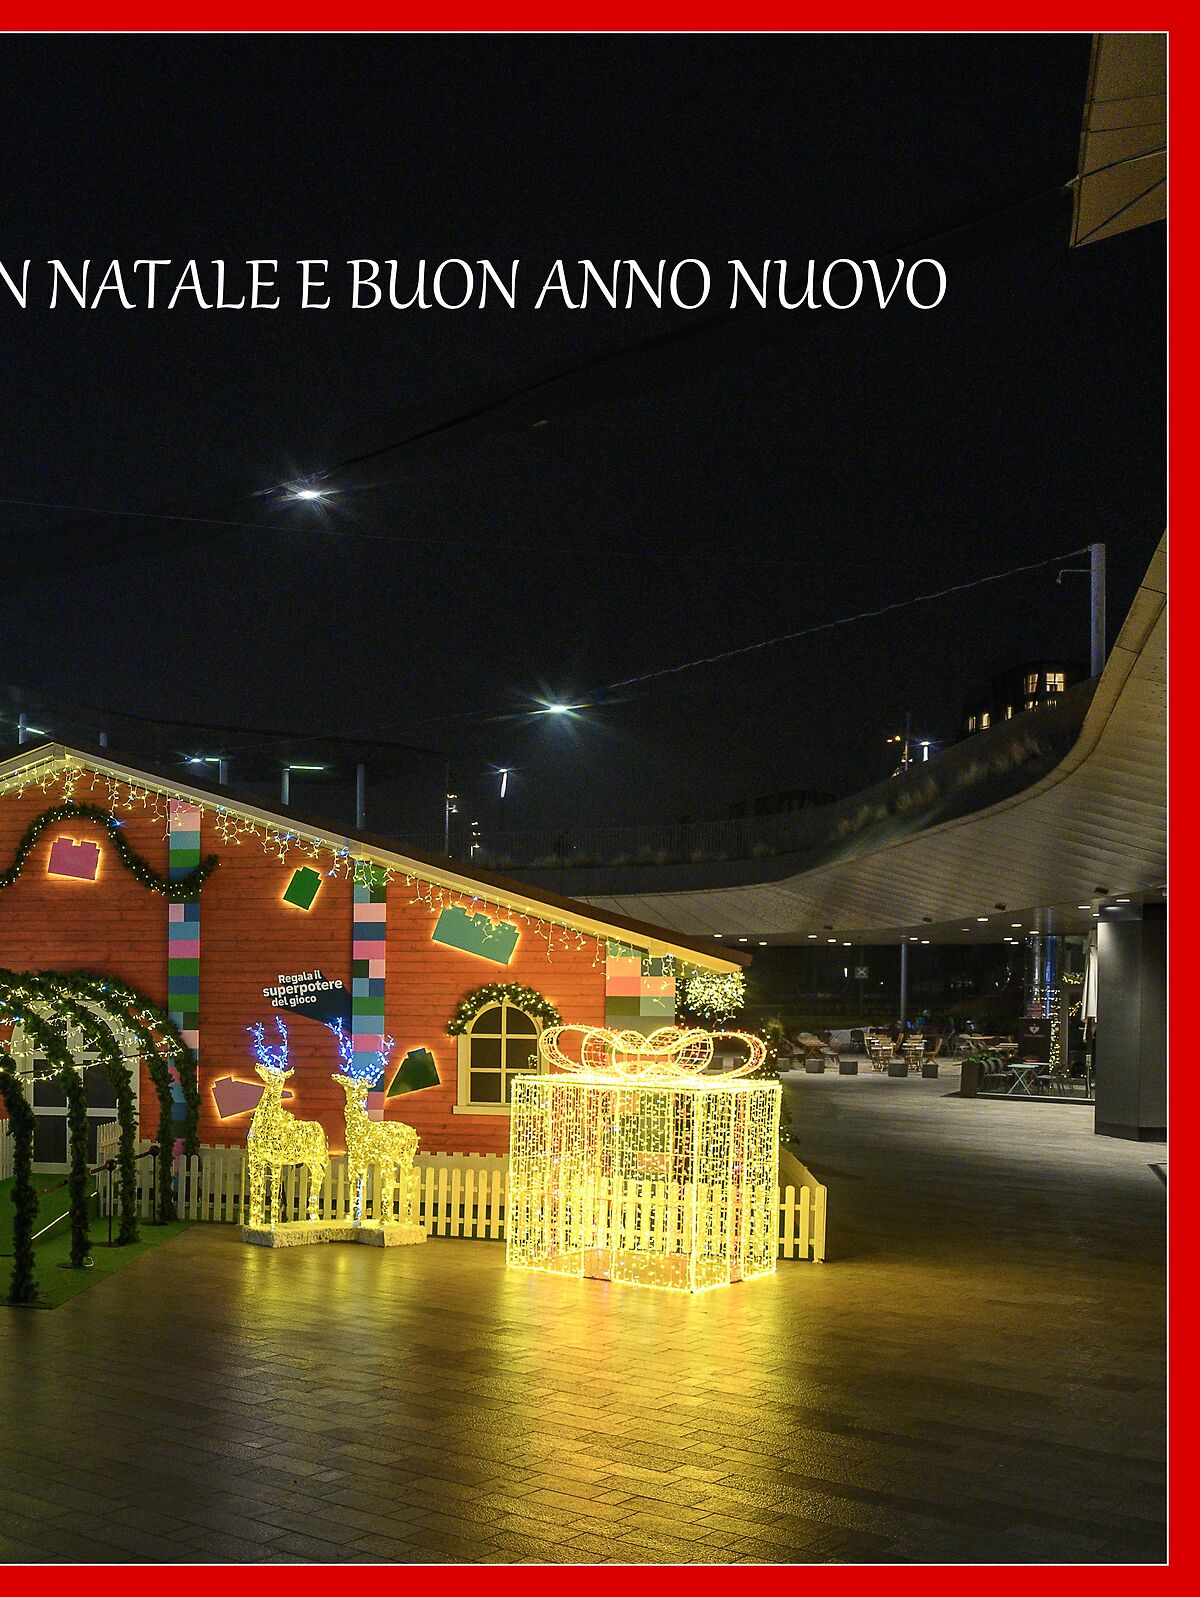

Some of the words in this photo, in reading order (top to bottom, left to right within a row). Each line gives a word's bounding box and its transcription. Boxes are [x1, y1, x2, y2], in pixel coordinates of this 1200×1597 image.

[278, 971, 313, 984] Regala
[314, 969, 322, 980] il
[262, 979, 343, 998] superpotere
[271, 996, 288, 1007] del
[289, 994, 317, 1007] gioco
